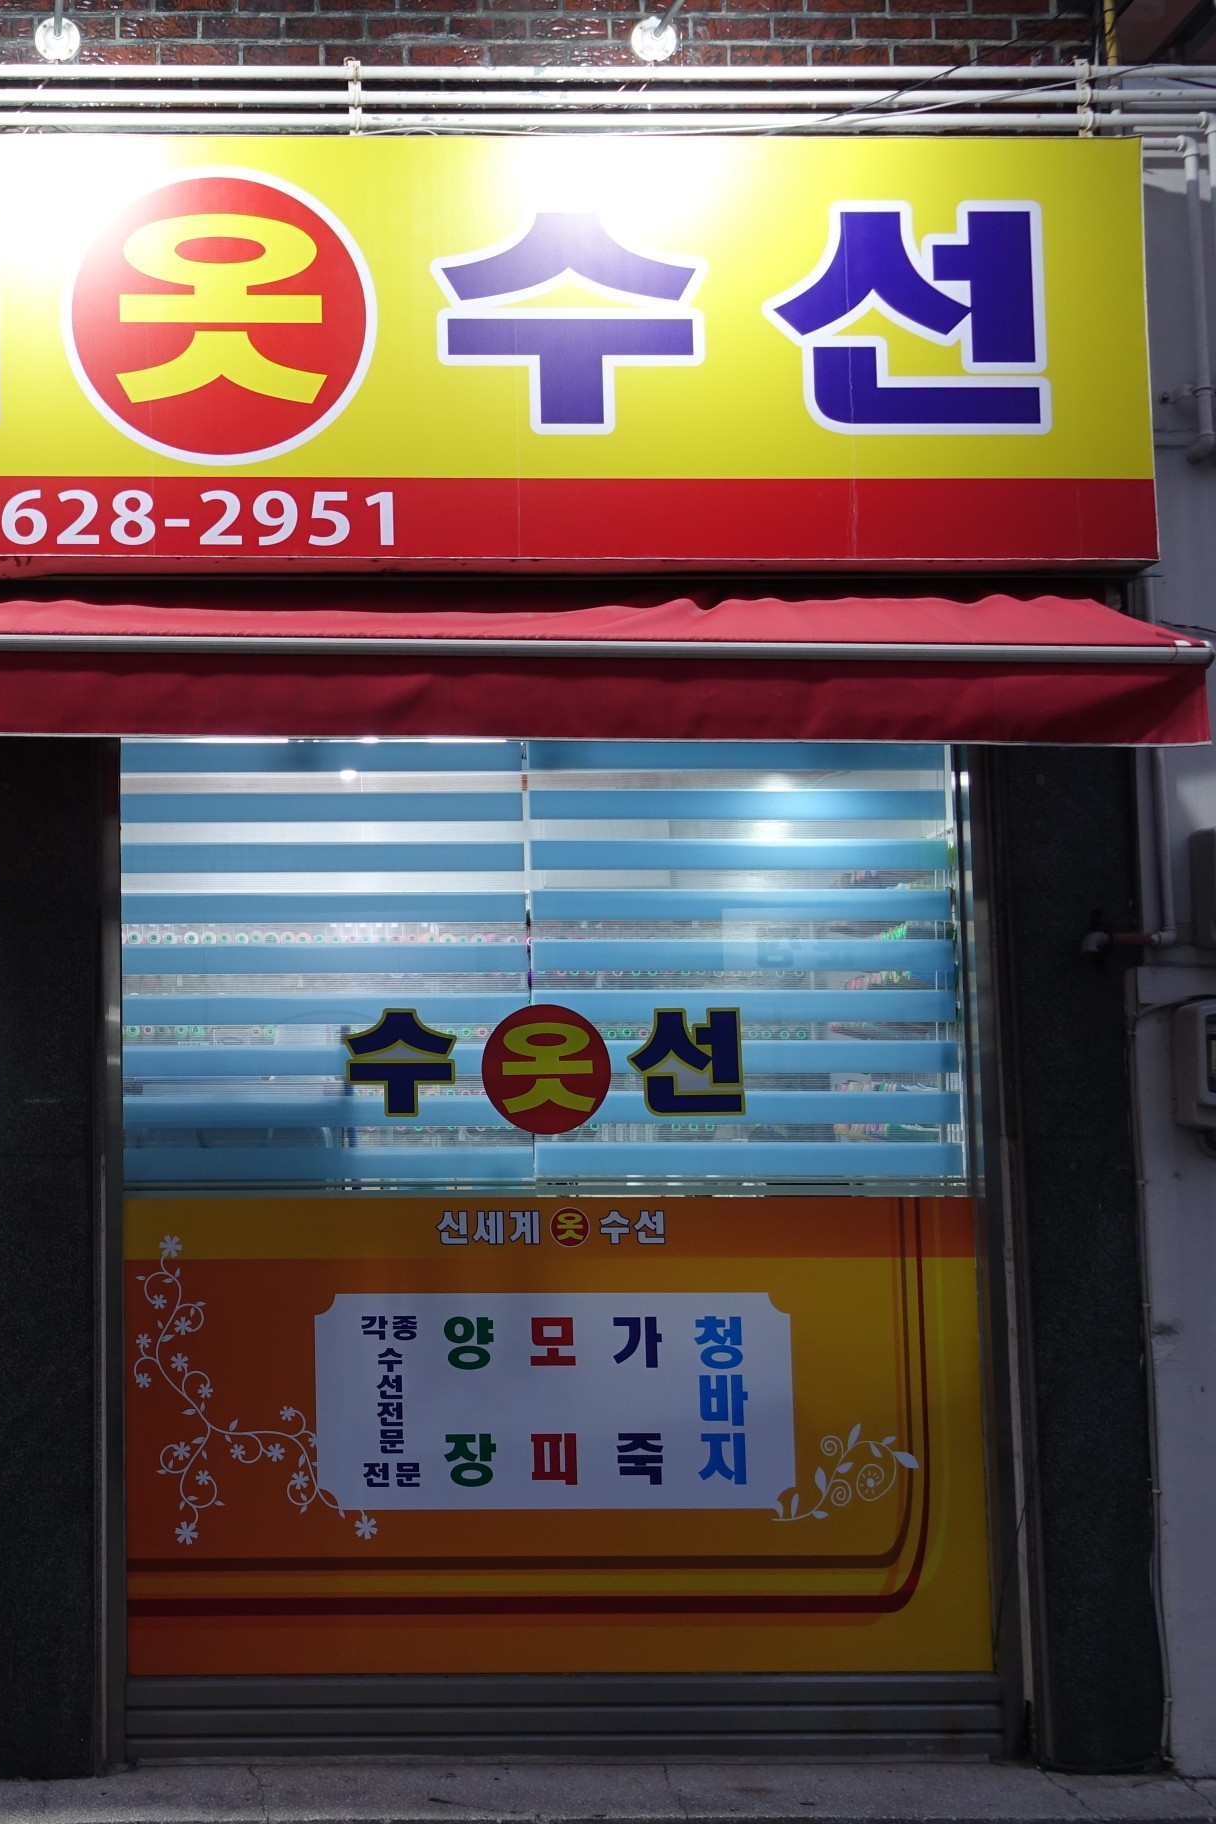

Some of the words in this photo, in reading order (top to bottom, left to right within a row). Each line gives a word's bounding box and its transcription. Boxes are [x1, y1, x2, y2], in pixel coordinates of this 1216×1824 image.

[116, 212, 329, 404] 옷
[430, 199, 1053, 436] 수선
[501, 1021, 596, 1114] 옷
[436, 1210, 541, 1246] 신세계
[555, 1212, 585, 1242] 옷
[598, 1210, 667, 1245] 수선
[361, 1315, 419, 1341] 각종
[376, 1346, 405, 1455] 수선전문
[694, 1315, 749, 1486] 청바지
[362, 1462, 422, 1488] 전문
